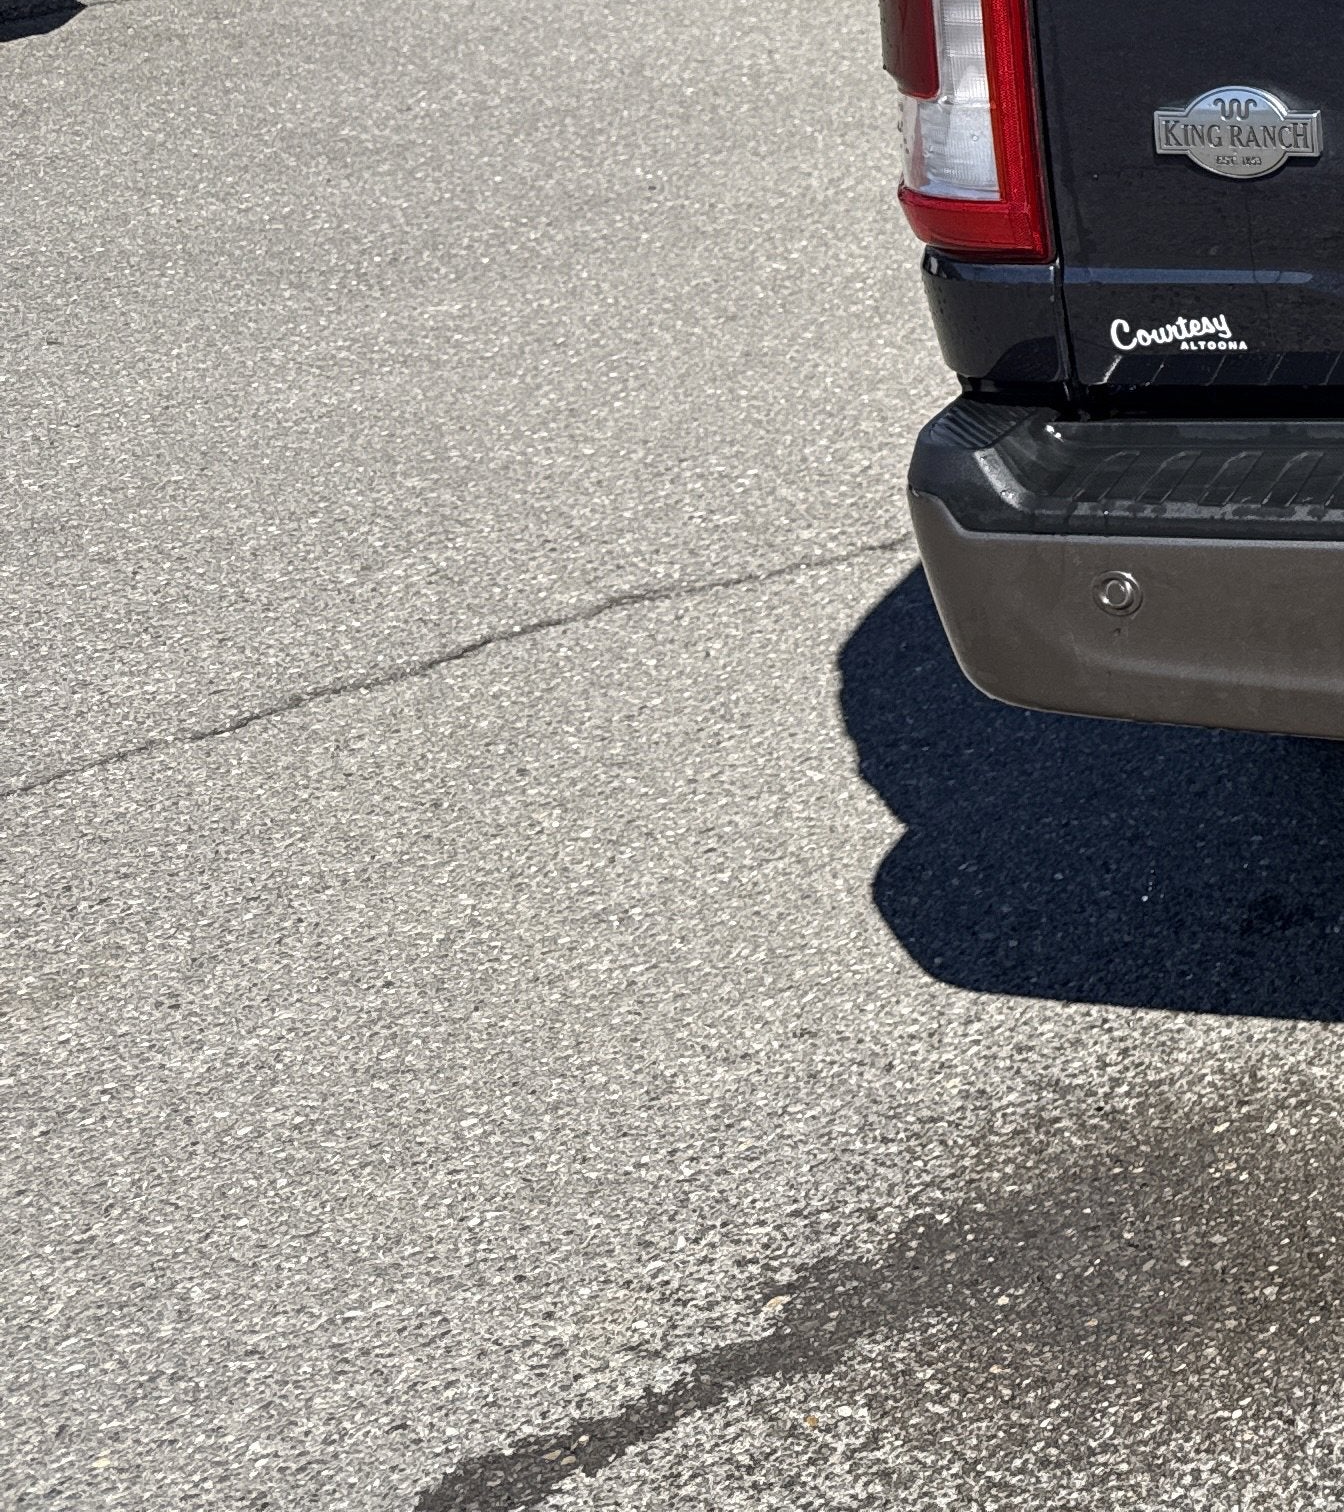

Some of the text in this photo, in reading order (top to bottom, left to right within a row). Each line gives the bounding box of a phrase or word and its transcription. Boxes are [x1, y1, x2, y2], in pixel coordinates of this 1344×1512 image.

[1162, 119, 1310, 150] KING RANCH
[1110, 313, 1233, 351] Courtesy
[1179, 340, 1248, 351] ALTOONA
